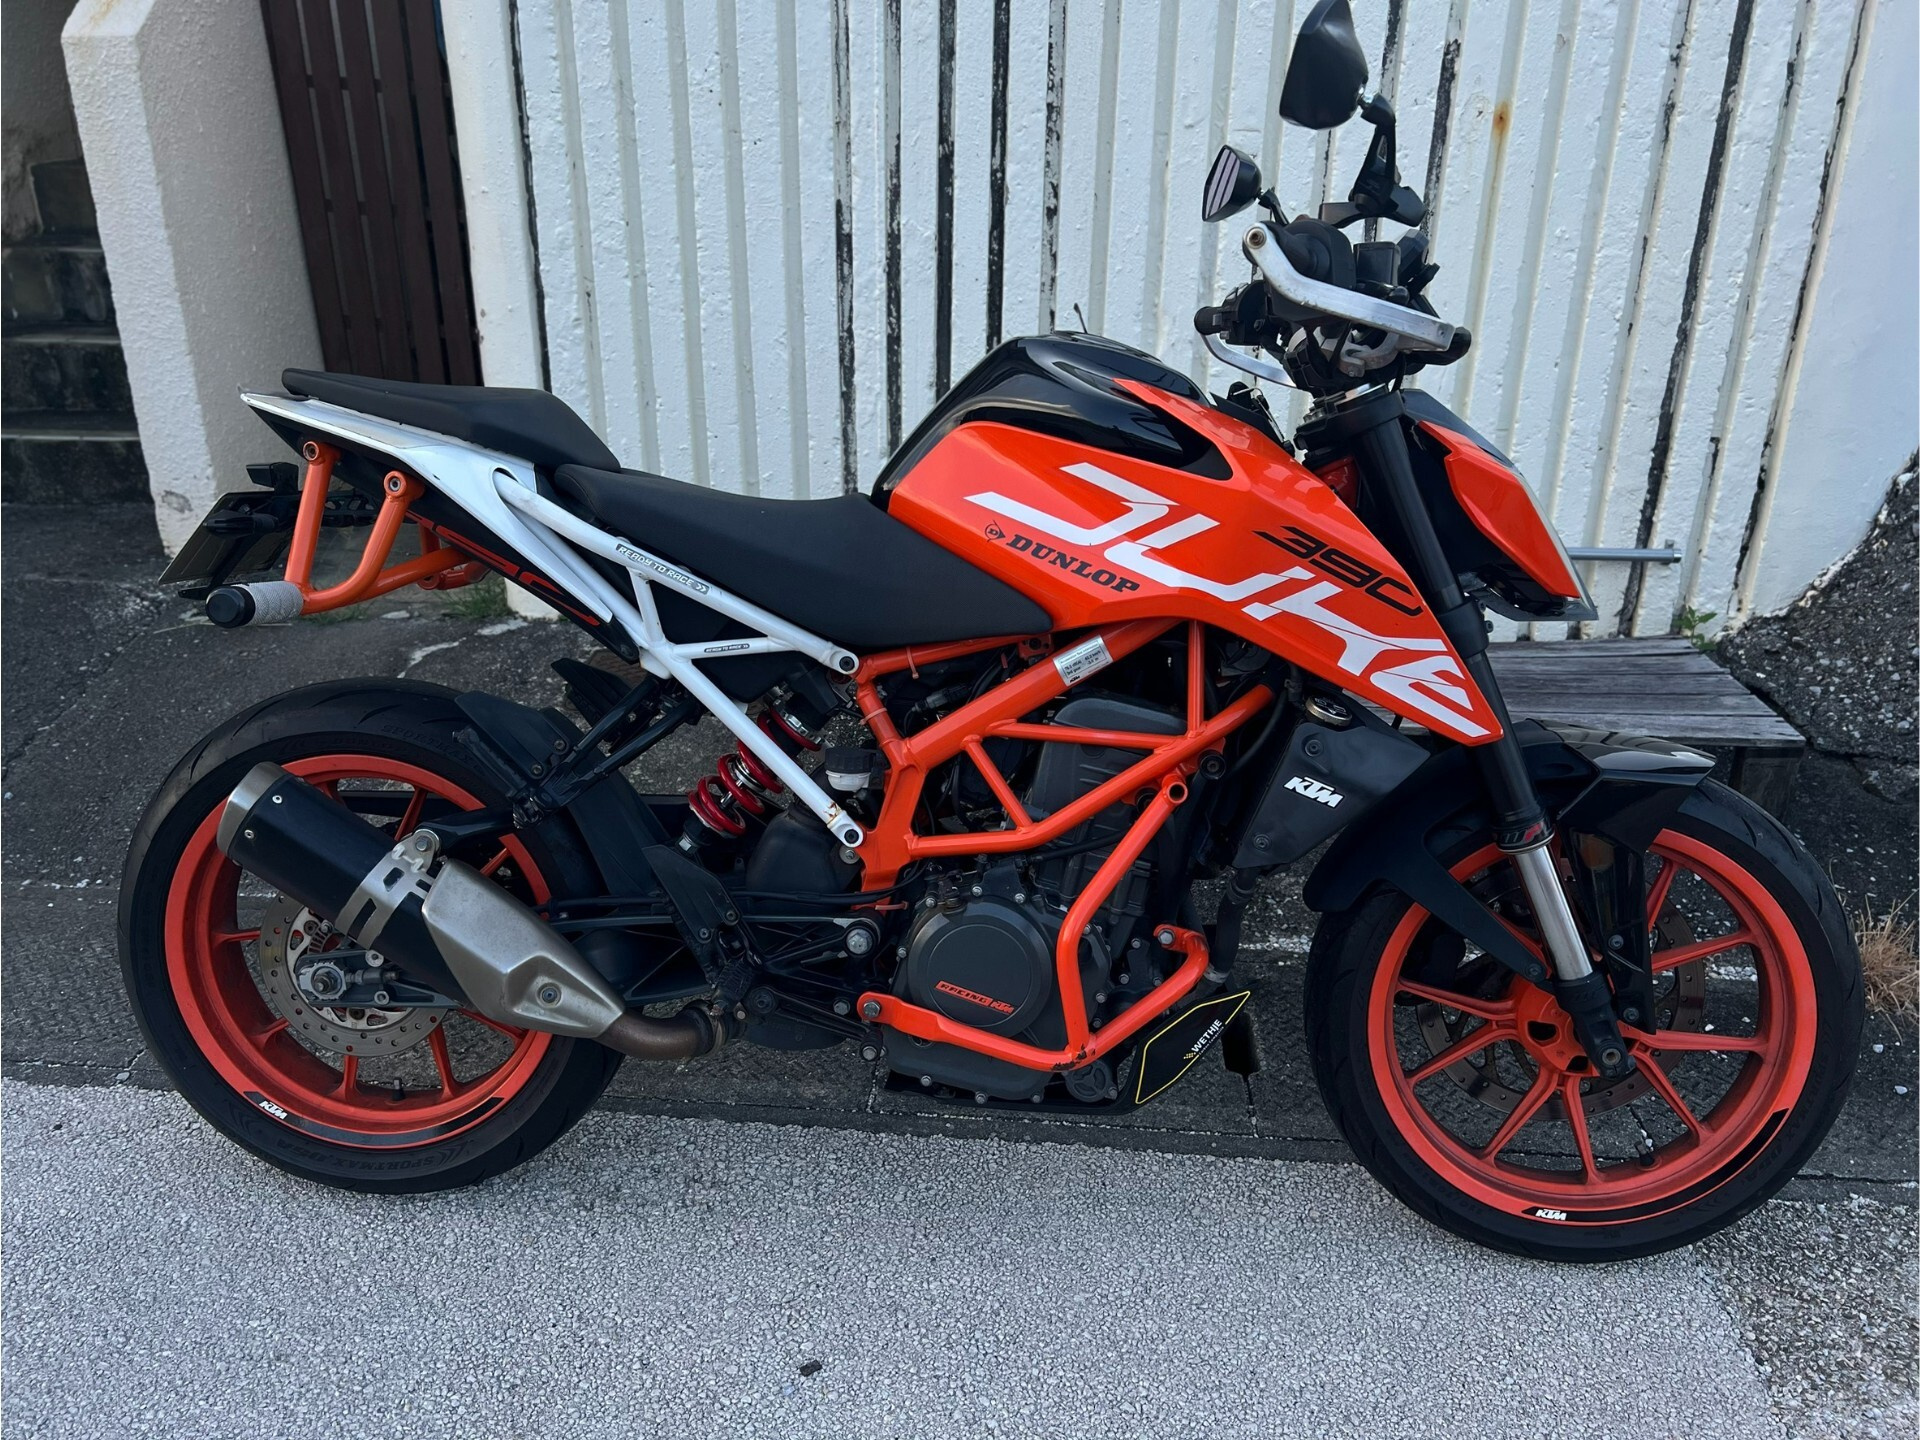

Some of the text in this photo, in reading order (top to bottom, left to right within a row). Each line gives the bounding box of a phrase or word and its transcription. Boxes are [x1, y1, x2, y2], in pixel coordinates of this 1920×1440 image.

[618, 545, 695, 586] READY TO RACE
[1006, 534, 1140, 592] DUNLOP
[963, 462, 1489, 738] DUKE
[1283, 776, 1344, 808] KTM
[939, 983, 1015, 1014] RACING KTM
[258, 1100, 288, 1120] KTM
[1535, 1209, 1567, 1221] KTM
